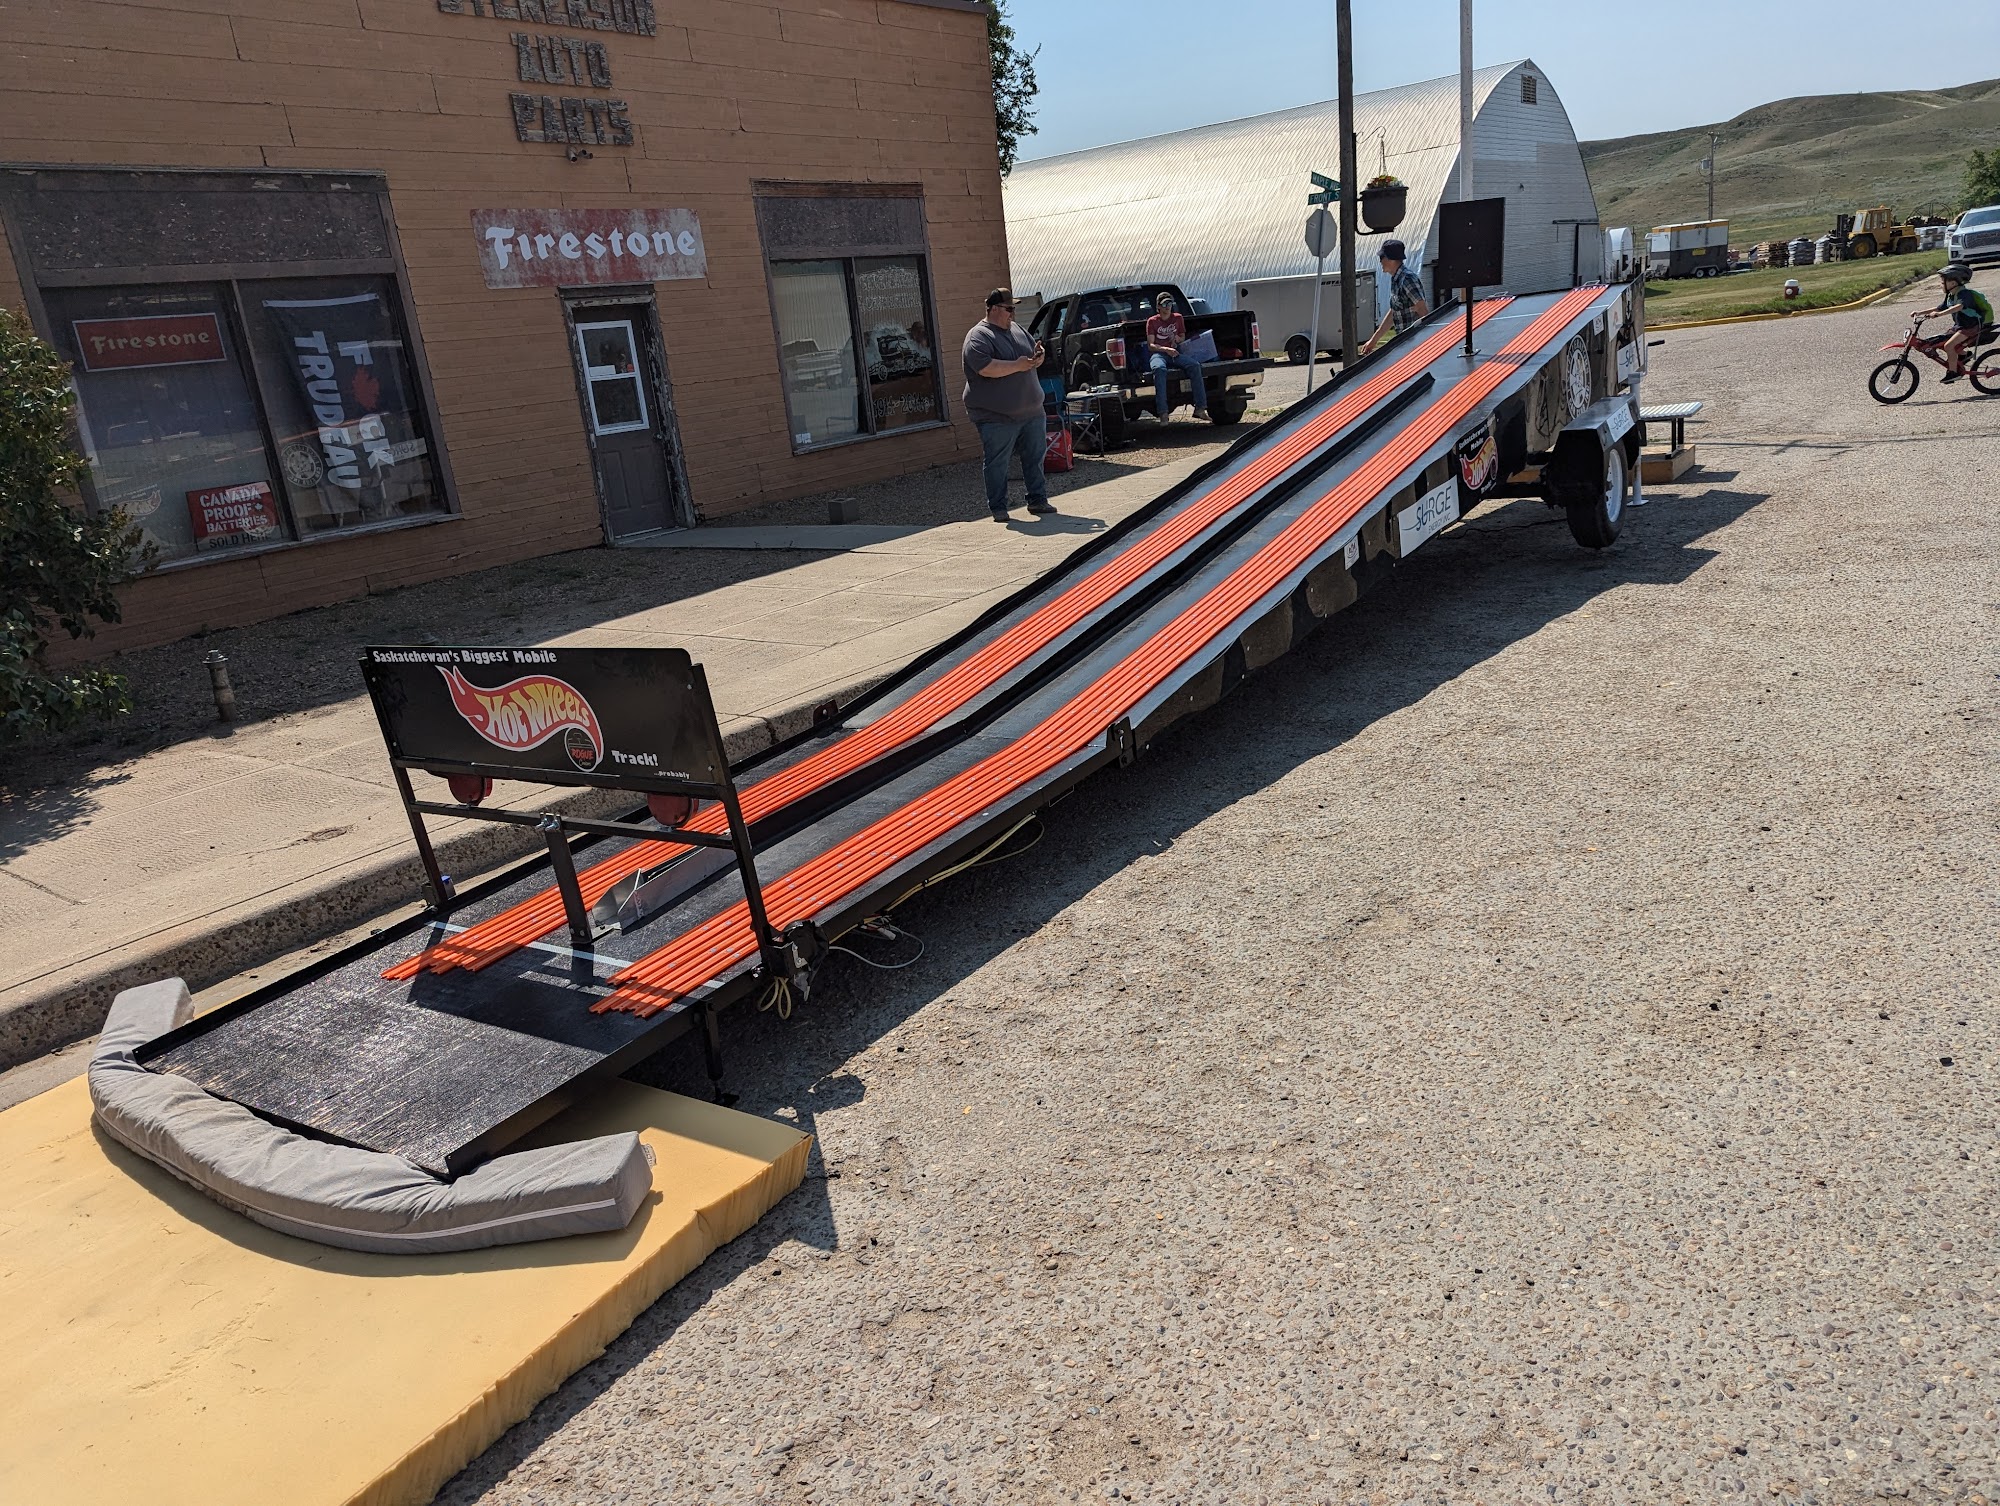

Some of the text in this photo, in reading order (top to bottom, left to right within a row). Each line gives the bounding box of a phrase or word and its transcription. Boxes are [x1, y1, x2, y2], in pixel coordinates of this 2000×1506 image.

[510, 32, 613, 88] AUTO
[510, 93, 634, 145] PARTS
[1310, 191, 1340, 203] FRONT S
[485, 226, 696, 270] Firestone
[90, 331, 210, 355] Firestone
[294, 330, 362, 489] TRUDEAU
[200, 486, 262, 508] CANADA
[203, 502, 252, 522] PROOF
[1415, 485, 1452, 532] SURGE
[206, 514, 268, 533] BATTERIES
[209, 533, 239, 549] SOLD
[373, 650, 557, 664] Saskatchewan's Biggest Mobile
[570, 747, 594, 761] ROGUE
[611, 749, 659, 767] Track!
